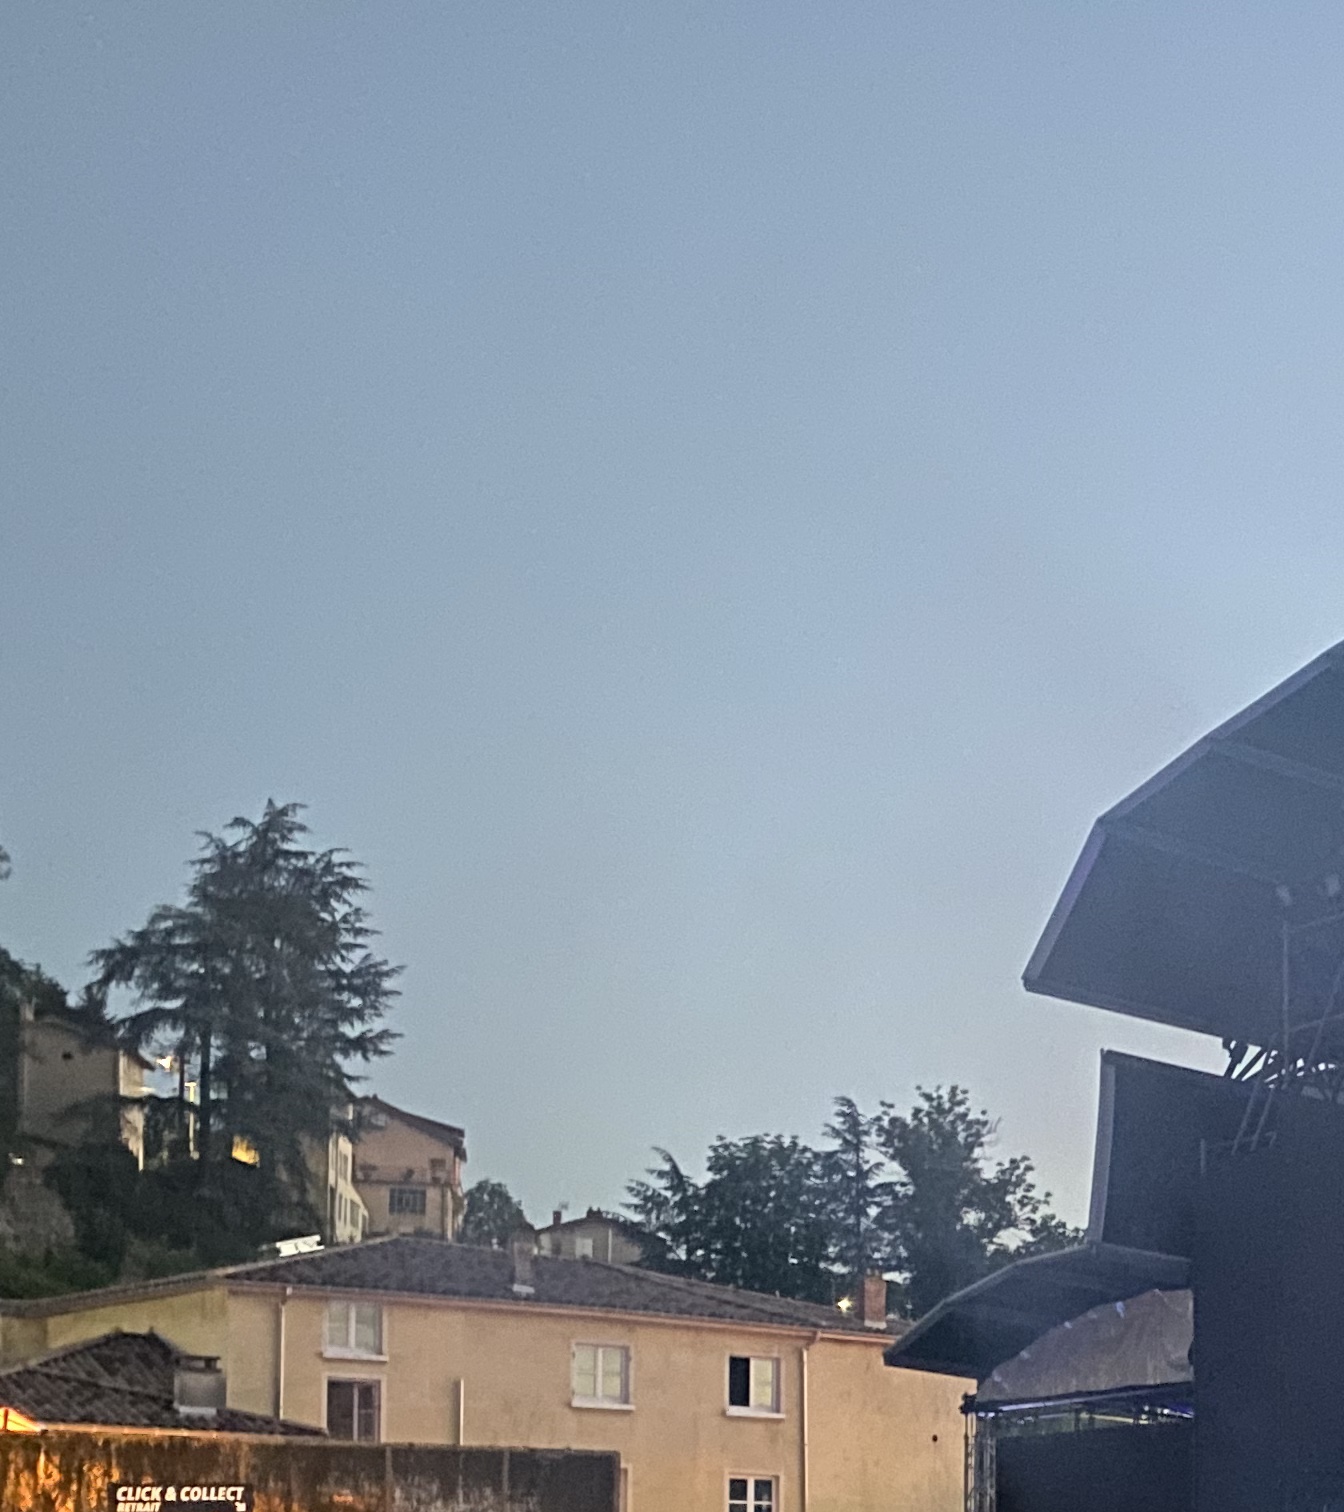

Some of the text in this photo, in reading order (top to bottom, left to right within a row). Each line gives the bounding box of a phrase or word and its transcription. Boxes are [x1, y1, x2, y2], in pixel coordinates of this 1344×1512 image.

[116, 1486, 245, 1501] CLICK & COLLECT
[116, 1502, 161, 1512] RETRAIT
